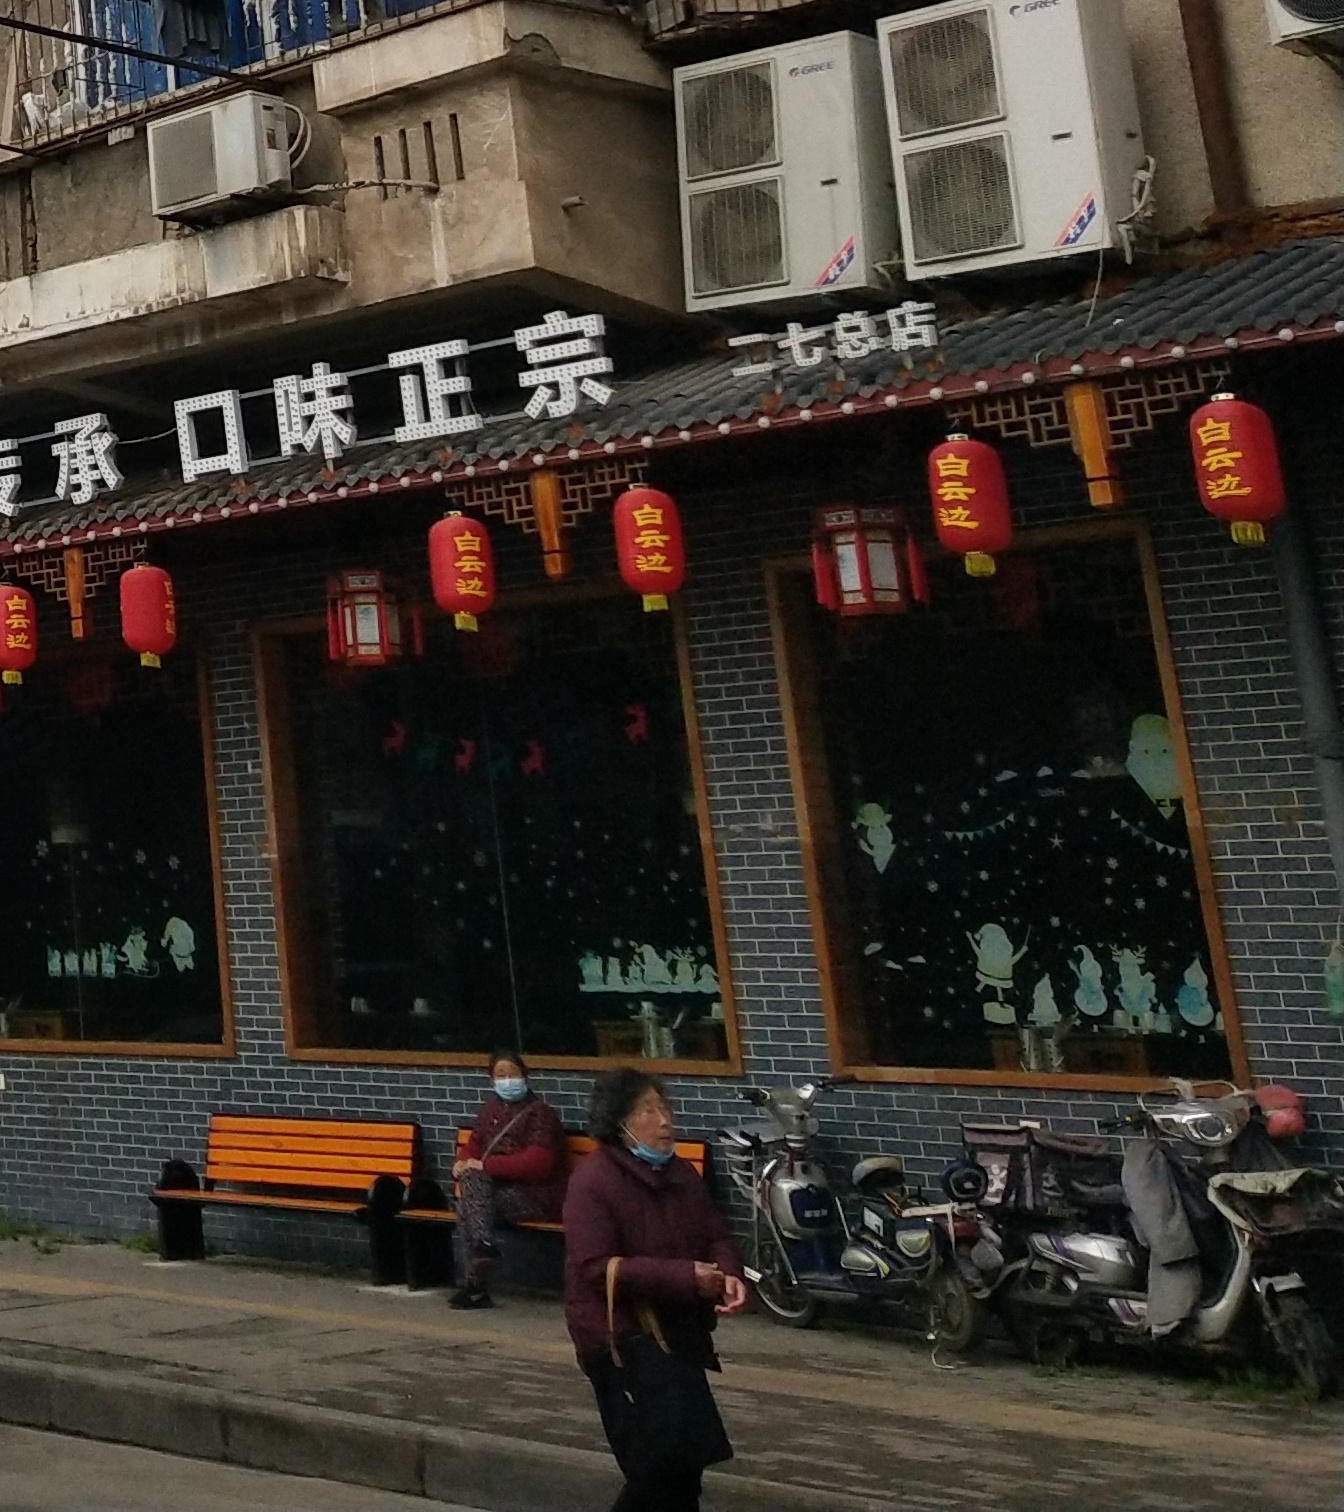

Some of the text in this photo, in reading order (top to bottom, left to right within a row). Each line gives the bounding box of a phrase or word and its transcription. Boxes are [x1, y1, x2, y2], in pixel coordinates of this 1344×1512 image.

[800, 60, 835, 76] GREE
[728, 299, 940, 377] 二七总店
[173, 310, 617, 484] 口味正宗
[935, 452, 979, 530] 白云边
[1196, 417, 1253, 500] 白云边
[452, 530, 489, 598] 白云边
[632, 503, 674, 574] 白云边
[5, 594, 33, 650] 白云边
